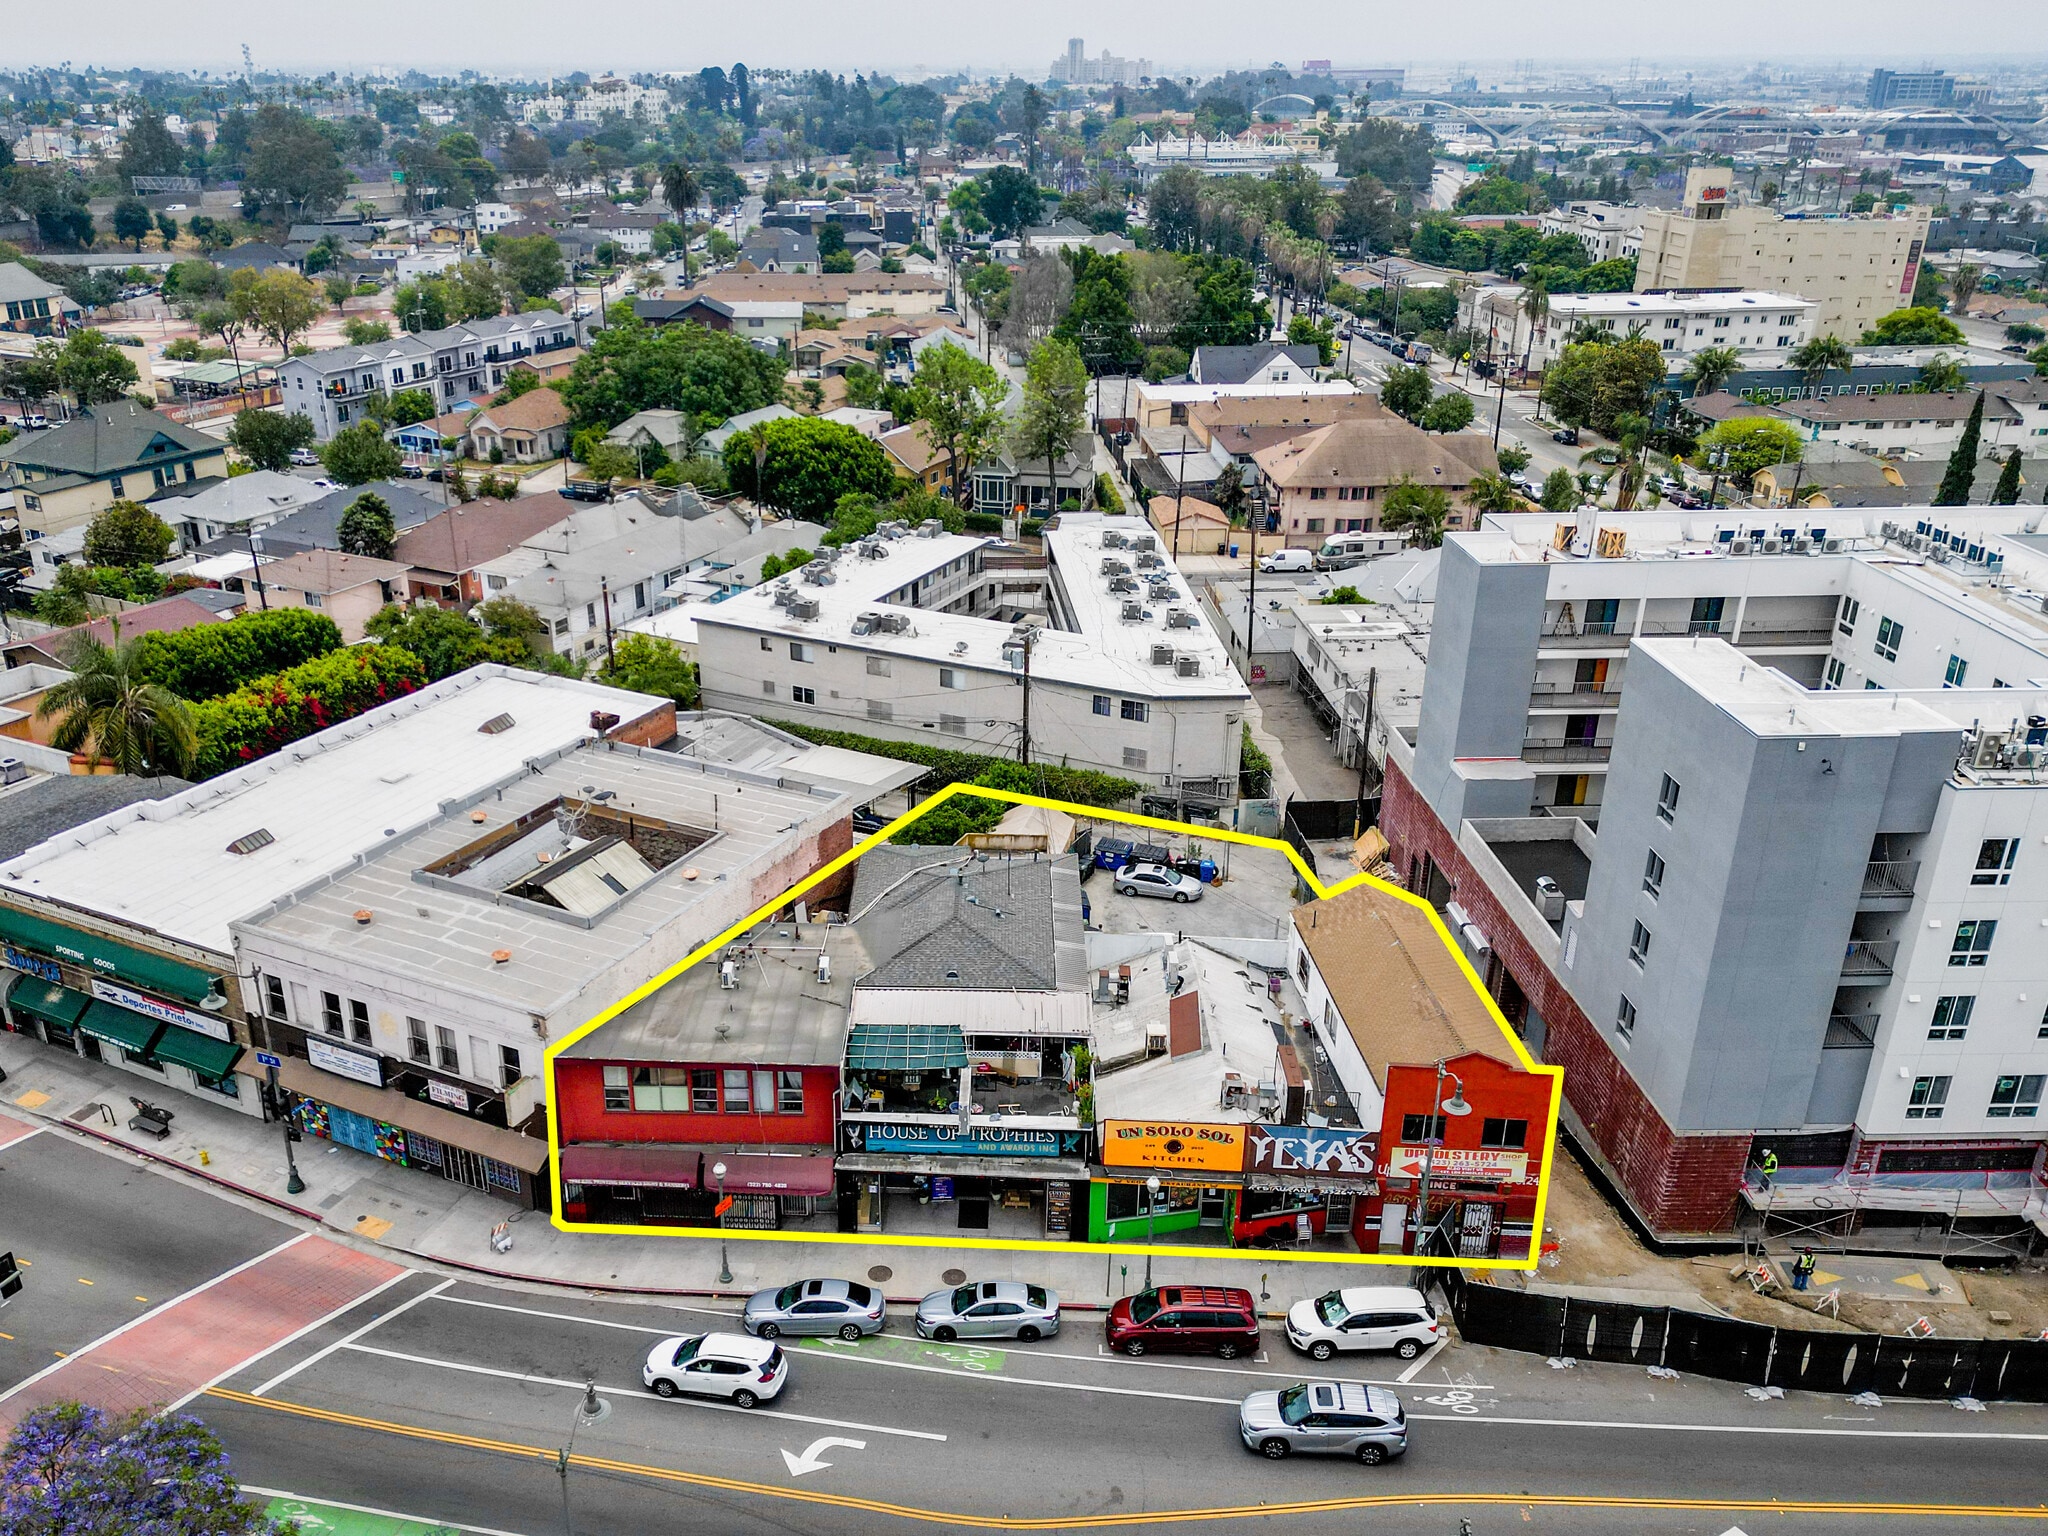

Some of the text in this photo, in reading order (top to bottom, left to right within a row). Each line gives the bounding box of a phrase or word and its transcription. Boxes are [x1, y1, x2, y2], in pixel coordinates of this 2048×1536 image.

[55, 945, 116, 971] SPORTING GOODS
[121, 994, 163, 1015] Deportes
[431, 1086, 465, 1102] FILMING
[868, 1124, 1056, 1143] HOUSE OF TROPHIES
[1115, 1125, 1235, 1145] UN SOLO SOL
[977, 1143, 997, 1152] AND
[1000, 1143, 1036, 1152] AWARDS
[1142, 1154, 1205, 1164] KITCHEN
[1453, 1160, 1498, 1168] 263-5724
[1429, 1181, 1457, 1190] INCE
